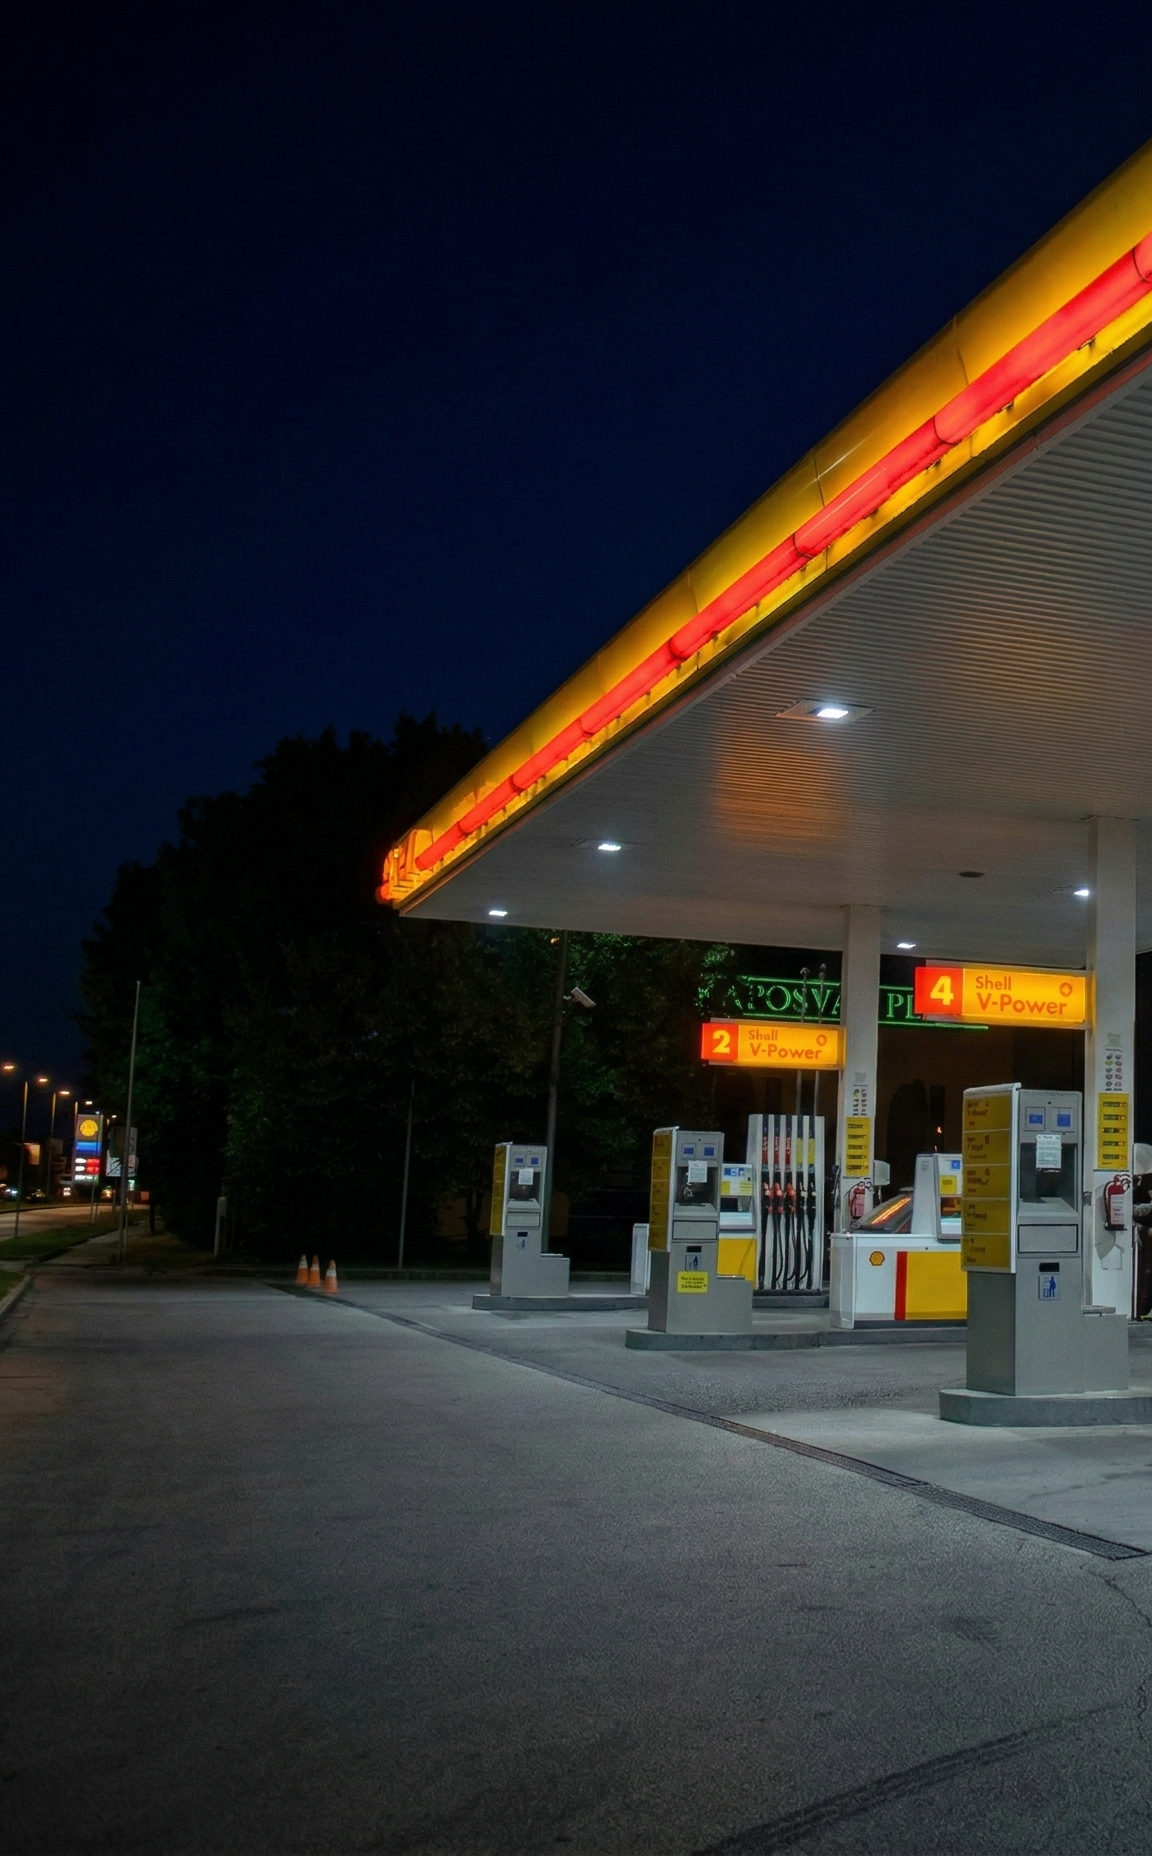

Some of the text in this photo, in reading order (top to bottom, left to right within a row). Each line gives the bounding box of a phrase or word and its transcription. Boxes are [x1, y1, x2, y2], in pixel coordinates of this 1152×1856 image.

[930, 975, 954, 1006] 4
[975, 974, 1012, 991] Shell
[976, 992, 1067, 1015] V-Power
[712, 1030, 731, 1054] 2
[749, 1042, 823, 1060] V-Power
